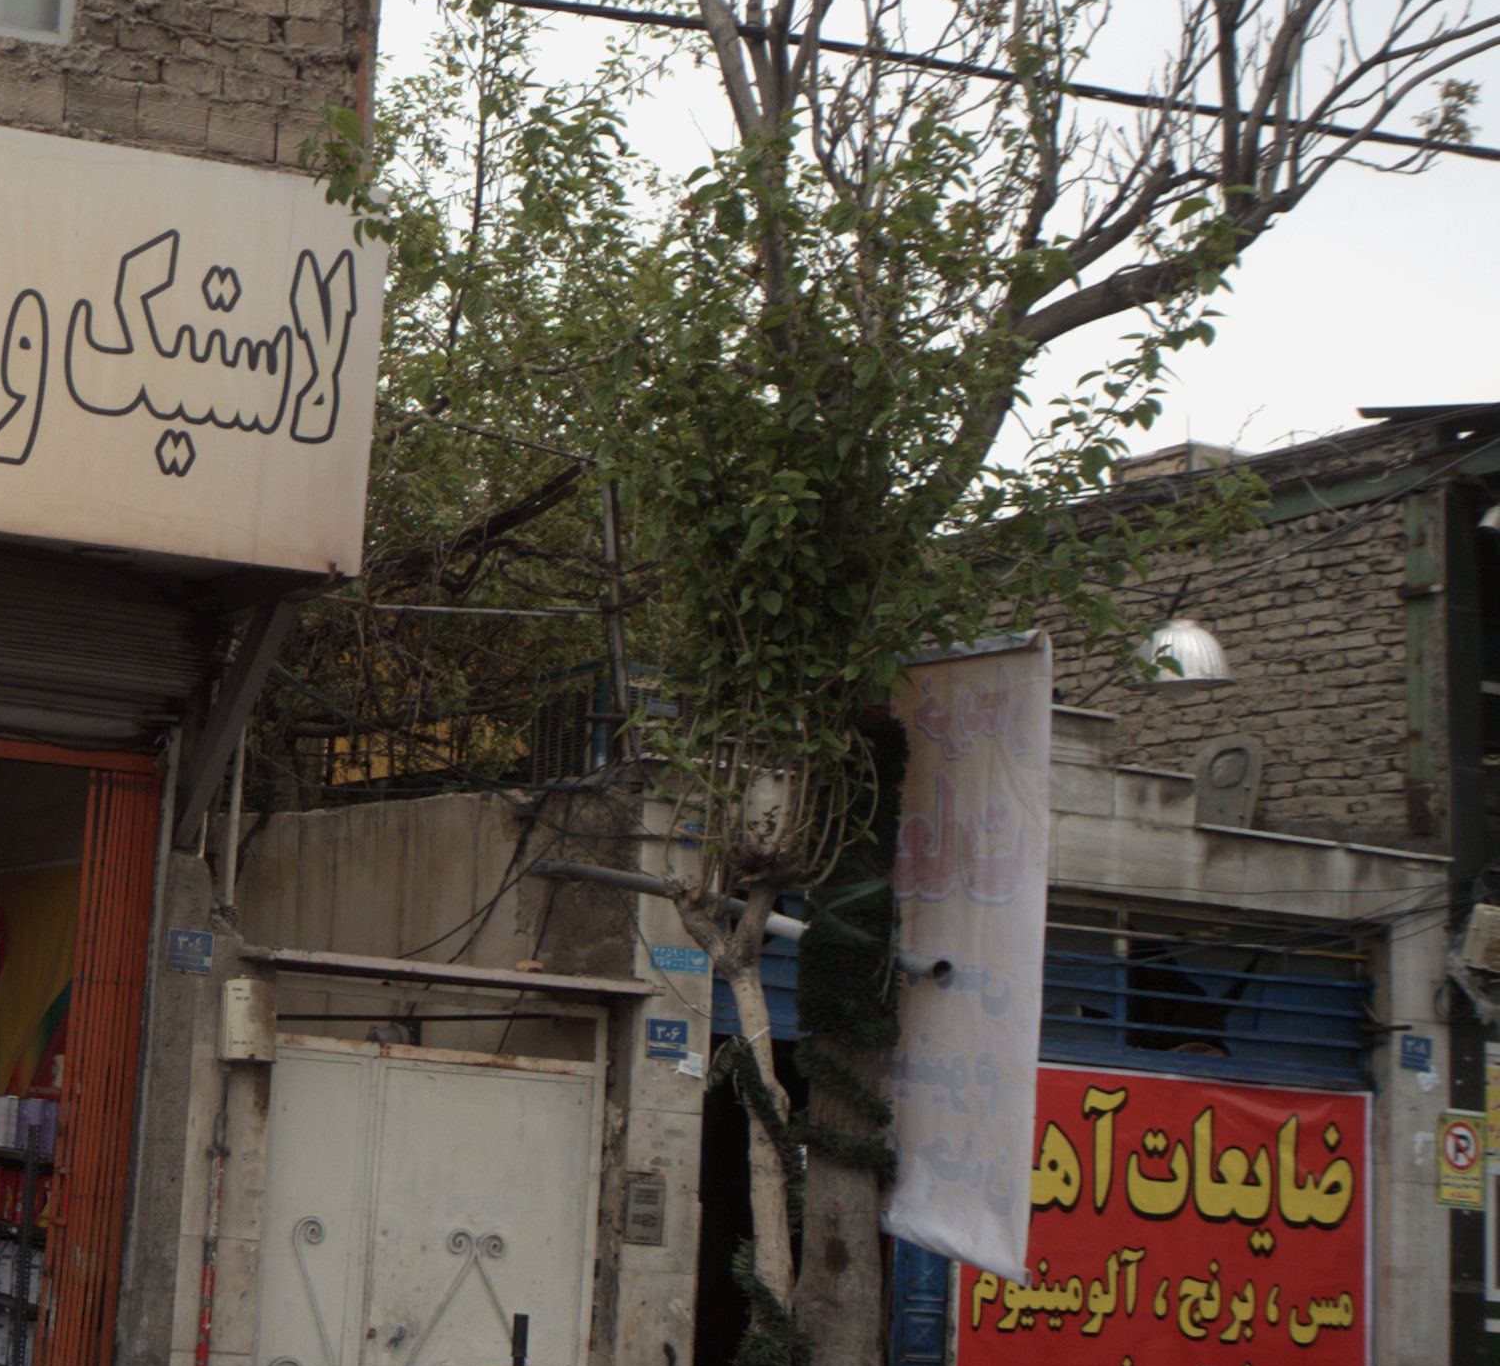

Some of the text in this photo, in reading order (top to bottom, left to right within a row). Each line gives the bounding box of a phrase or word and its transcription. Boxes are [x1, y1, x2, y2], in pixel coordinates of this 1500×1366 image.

[65, 229, 357, 478] لاستیک
[1030, 1086, 1355, 1252] ضایعات آه
[970, 1247, 1147, 1336] آلومینیوم
